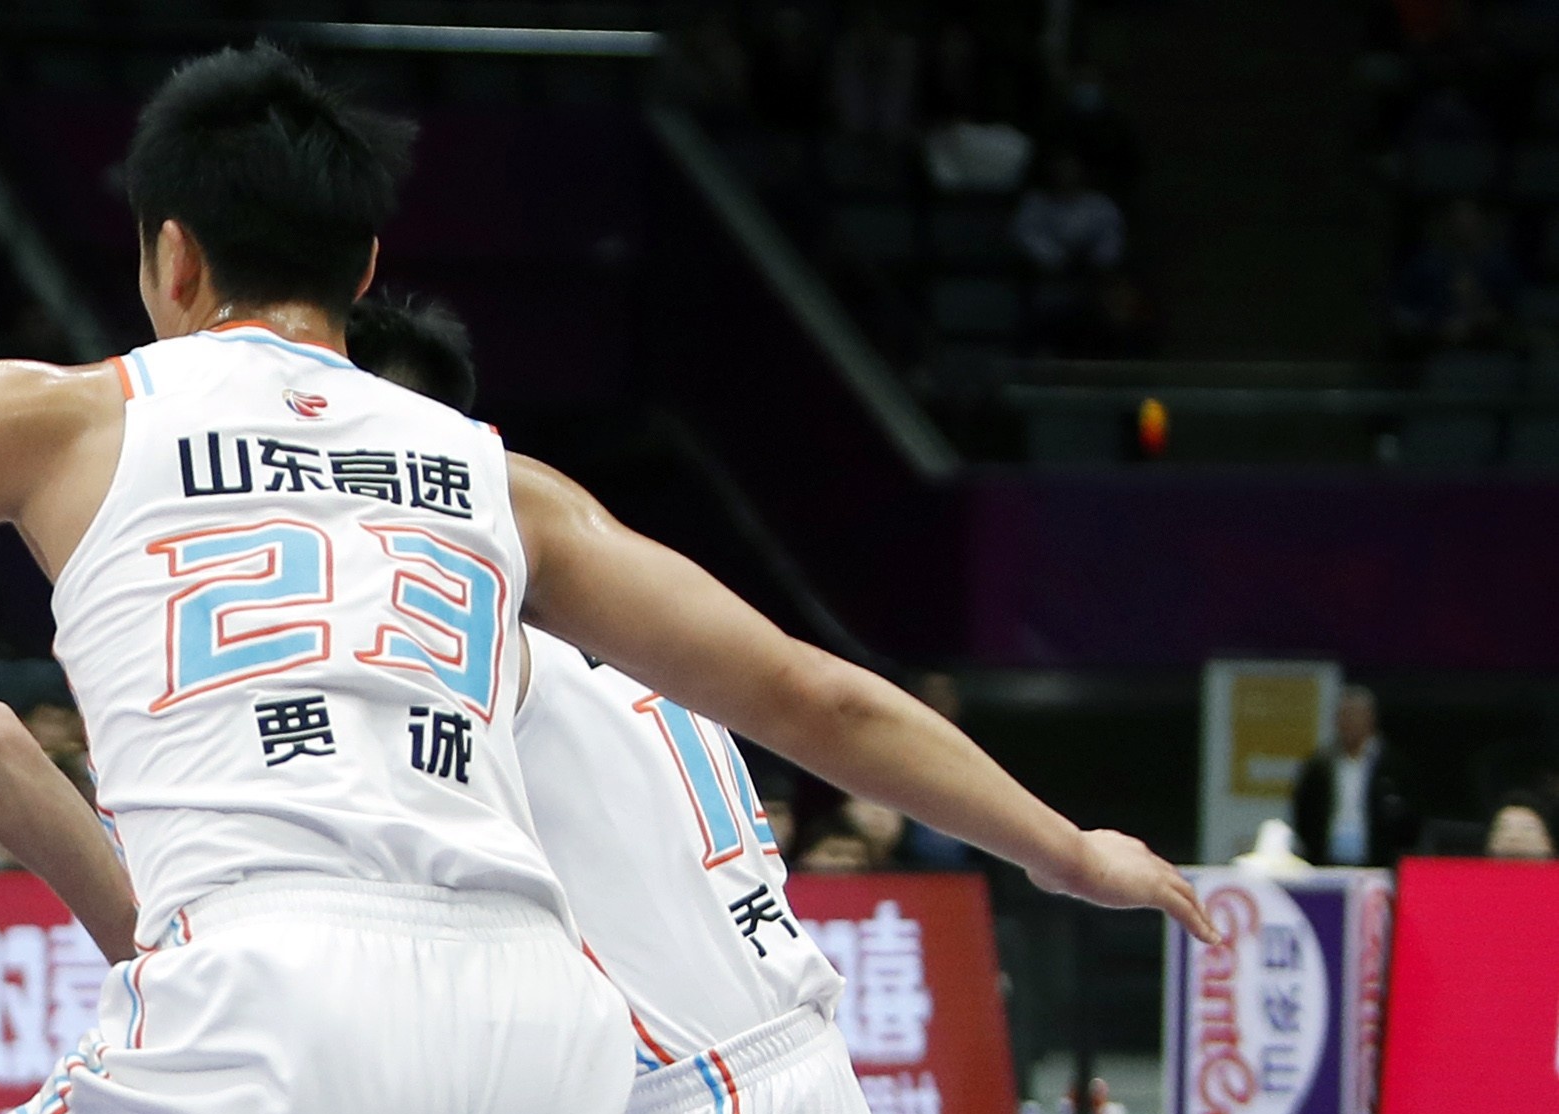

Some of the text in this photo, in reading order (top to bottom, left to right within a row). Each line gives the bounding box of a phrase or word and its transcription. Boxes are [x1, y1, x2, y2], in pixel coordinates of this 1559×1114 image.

[178, 431, 473, 519] 山东高速
[145, 518, 506, 725] 23
[255, 695, 473, 785] 贾 诚
